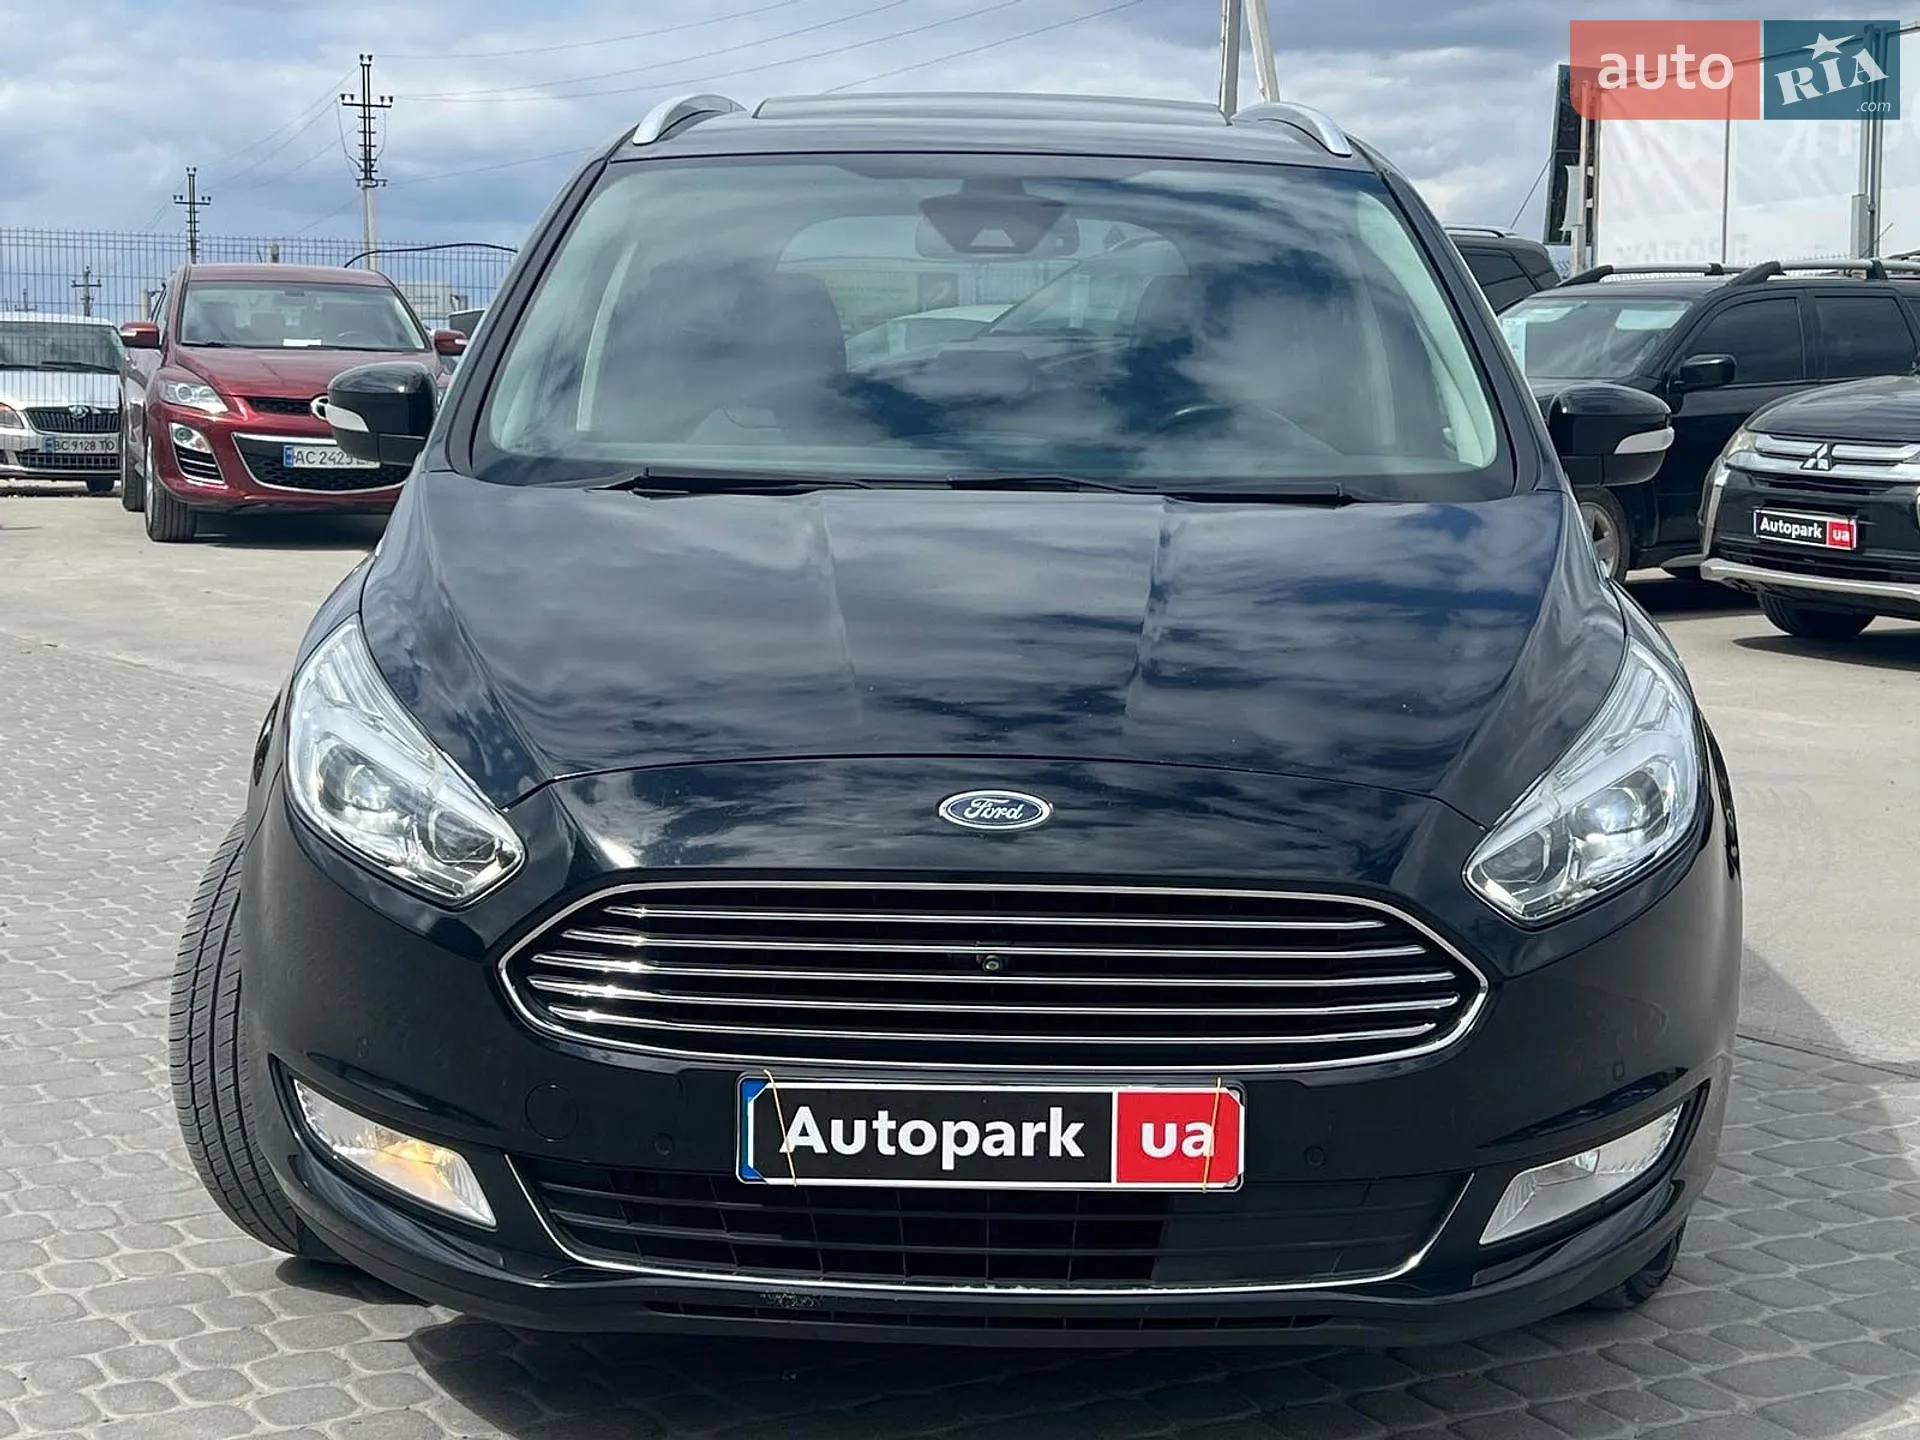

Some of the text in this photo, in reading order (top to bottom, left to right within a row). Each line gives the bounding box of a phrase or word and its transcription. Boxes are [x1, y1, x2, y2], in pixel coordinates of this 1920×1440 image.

[296, 451, 315, 465] AC
[1760, 516, 1850, 542] Autopark ua
[963, 798, 1024, 820] Ford
[779, 1105, 1216, 1171] Autopark ua
